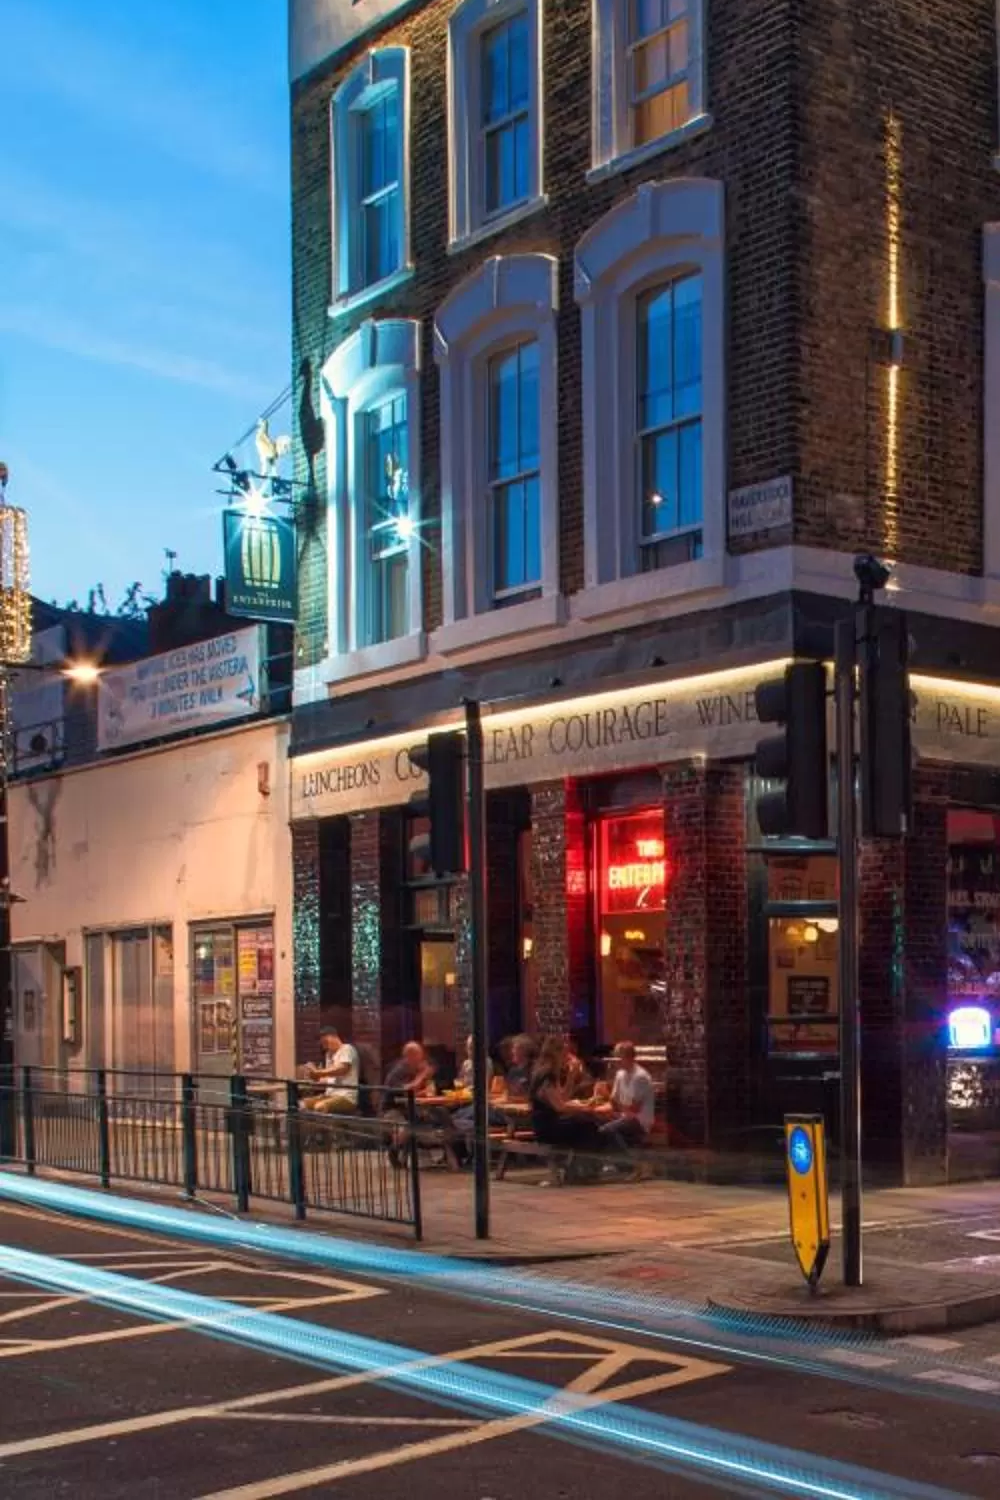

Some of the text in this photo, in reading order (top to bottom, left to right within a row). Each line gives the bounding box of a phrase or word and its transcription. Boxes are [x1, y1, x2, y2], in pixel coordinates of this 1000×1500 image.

[302, 758, 381, 798] LUNCHEONS
[482, 723, 535, 765] LEAR
[547, 698, 668, 755] COURAGE
[936, 701, 989, 738] PALE
